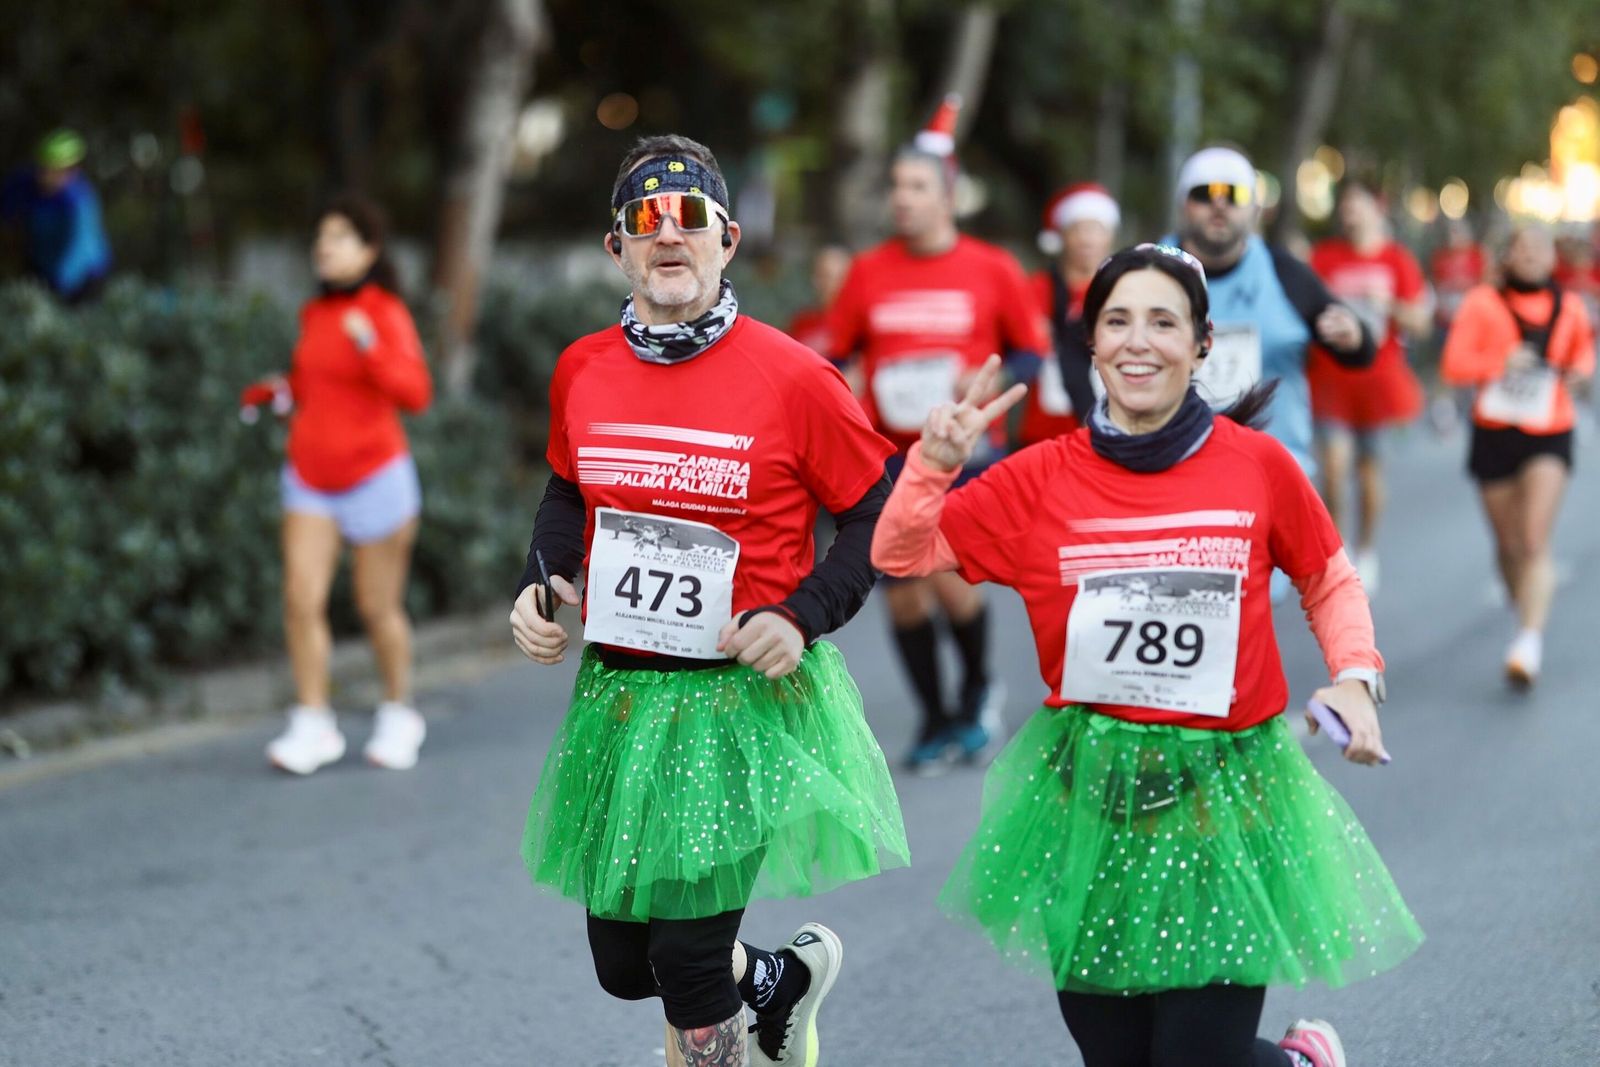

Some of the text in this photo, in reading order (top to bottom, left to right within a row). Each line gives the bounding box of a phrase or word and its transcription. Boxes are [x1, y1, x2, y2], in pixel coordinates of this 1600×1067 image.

[729, 434, 754, 450] XIV
[676, 453, 751, 475] CARRERA
[651, 463, 750, 487] SAN SILVESTRE
[614, 472, 748, 500] PALMA PALMILLA
[652, 498, 747, 515] MÁLAGA CIUDAD SALUDABLE
[690, 543, 733, 558] XIV
[1177, 536, 1252, 553] CARRERA
[1150, 553, 1178, 566] SAN
[614, 566, 702, 617] 473
[1104, 619, 1204, 668] 789
